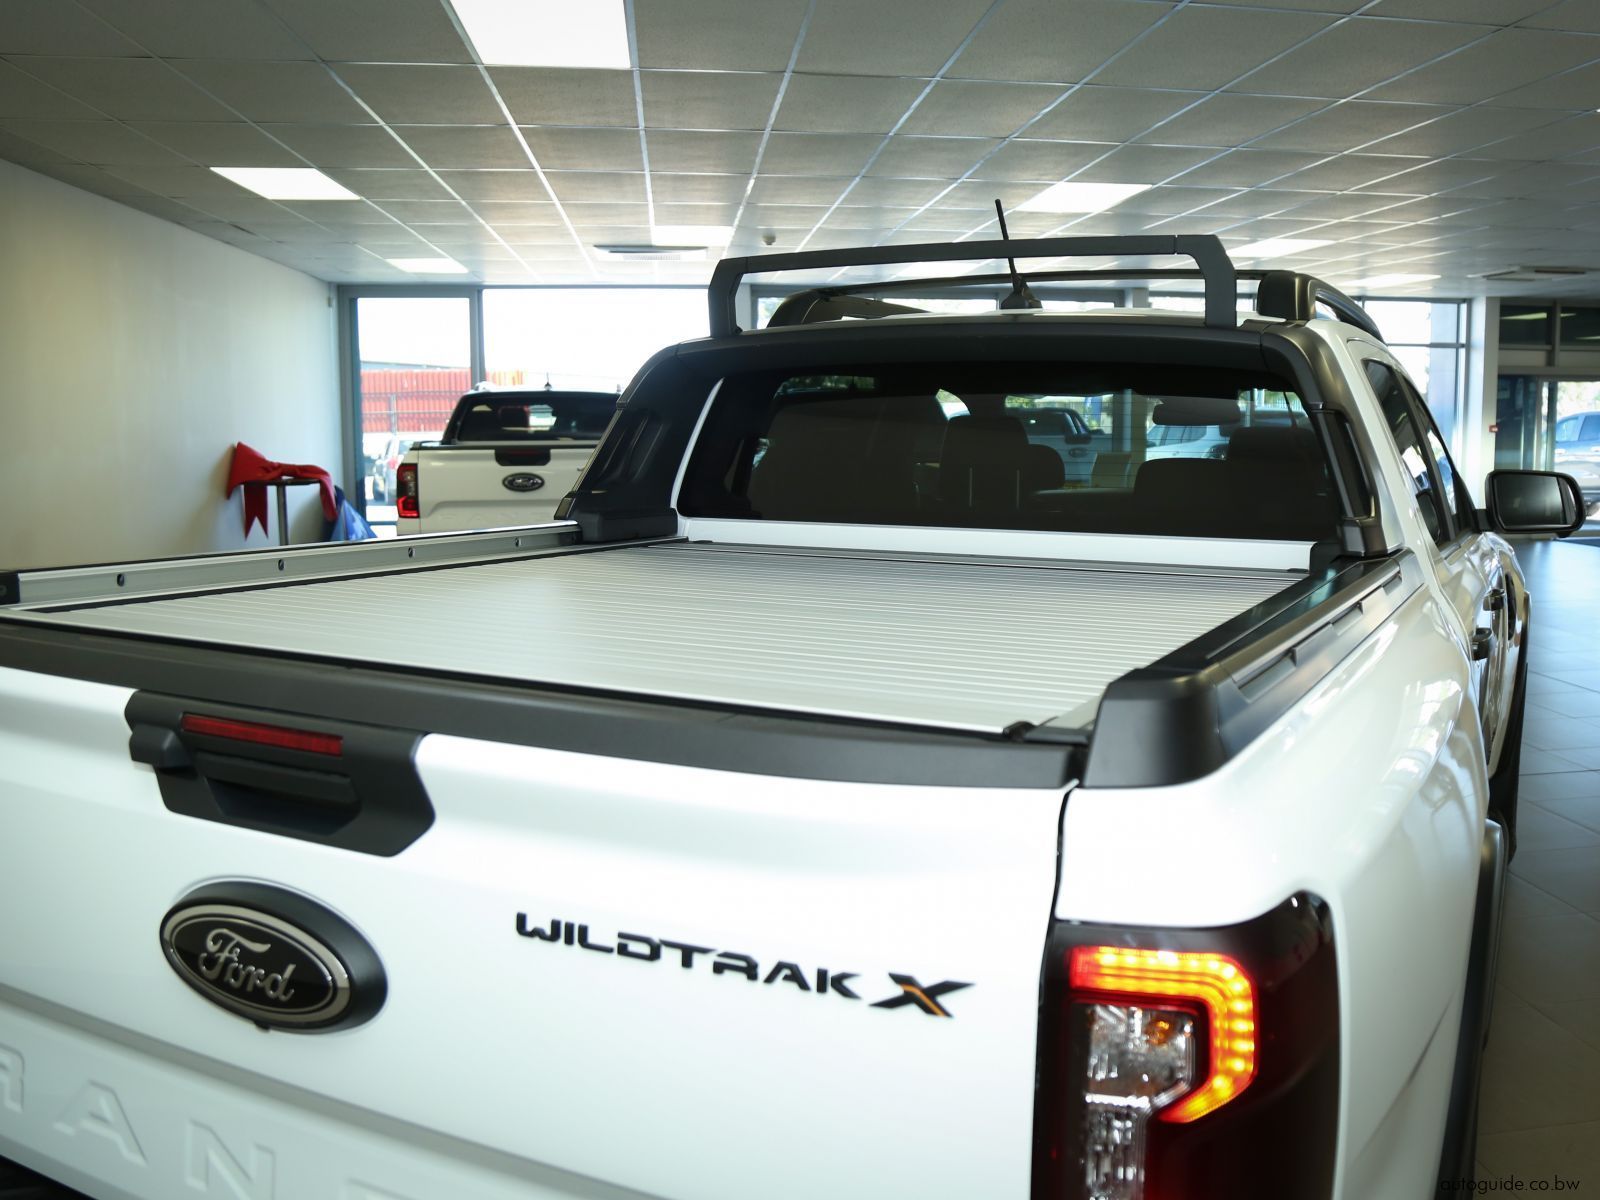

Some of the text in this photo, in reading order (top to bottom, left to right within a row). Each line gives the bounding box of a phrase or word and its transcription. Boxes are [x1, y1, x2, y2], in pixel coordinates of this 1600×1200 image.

[200, 928, 295, 1001] Ford
[516, 912, 976, 1018] WILDTRAK X
